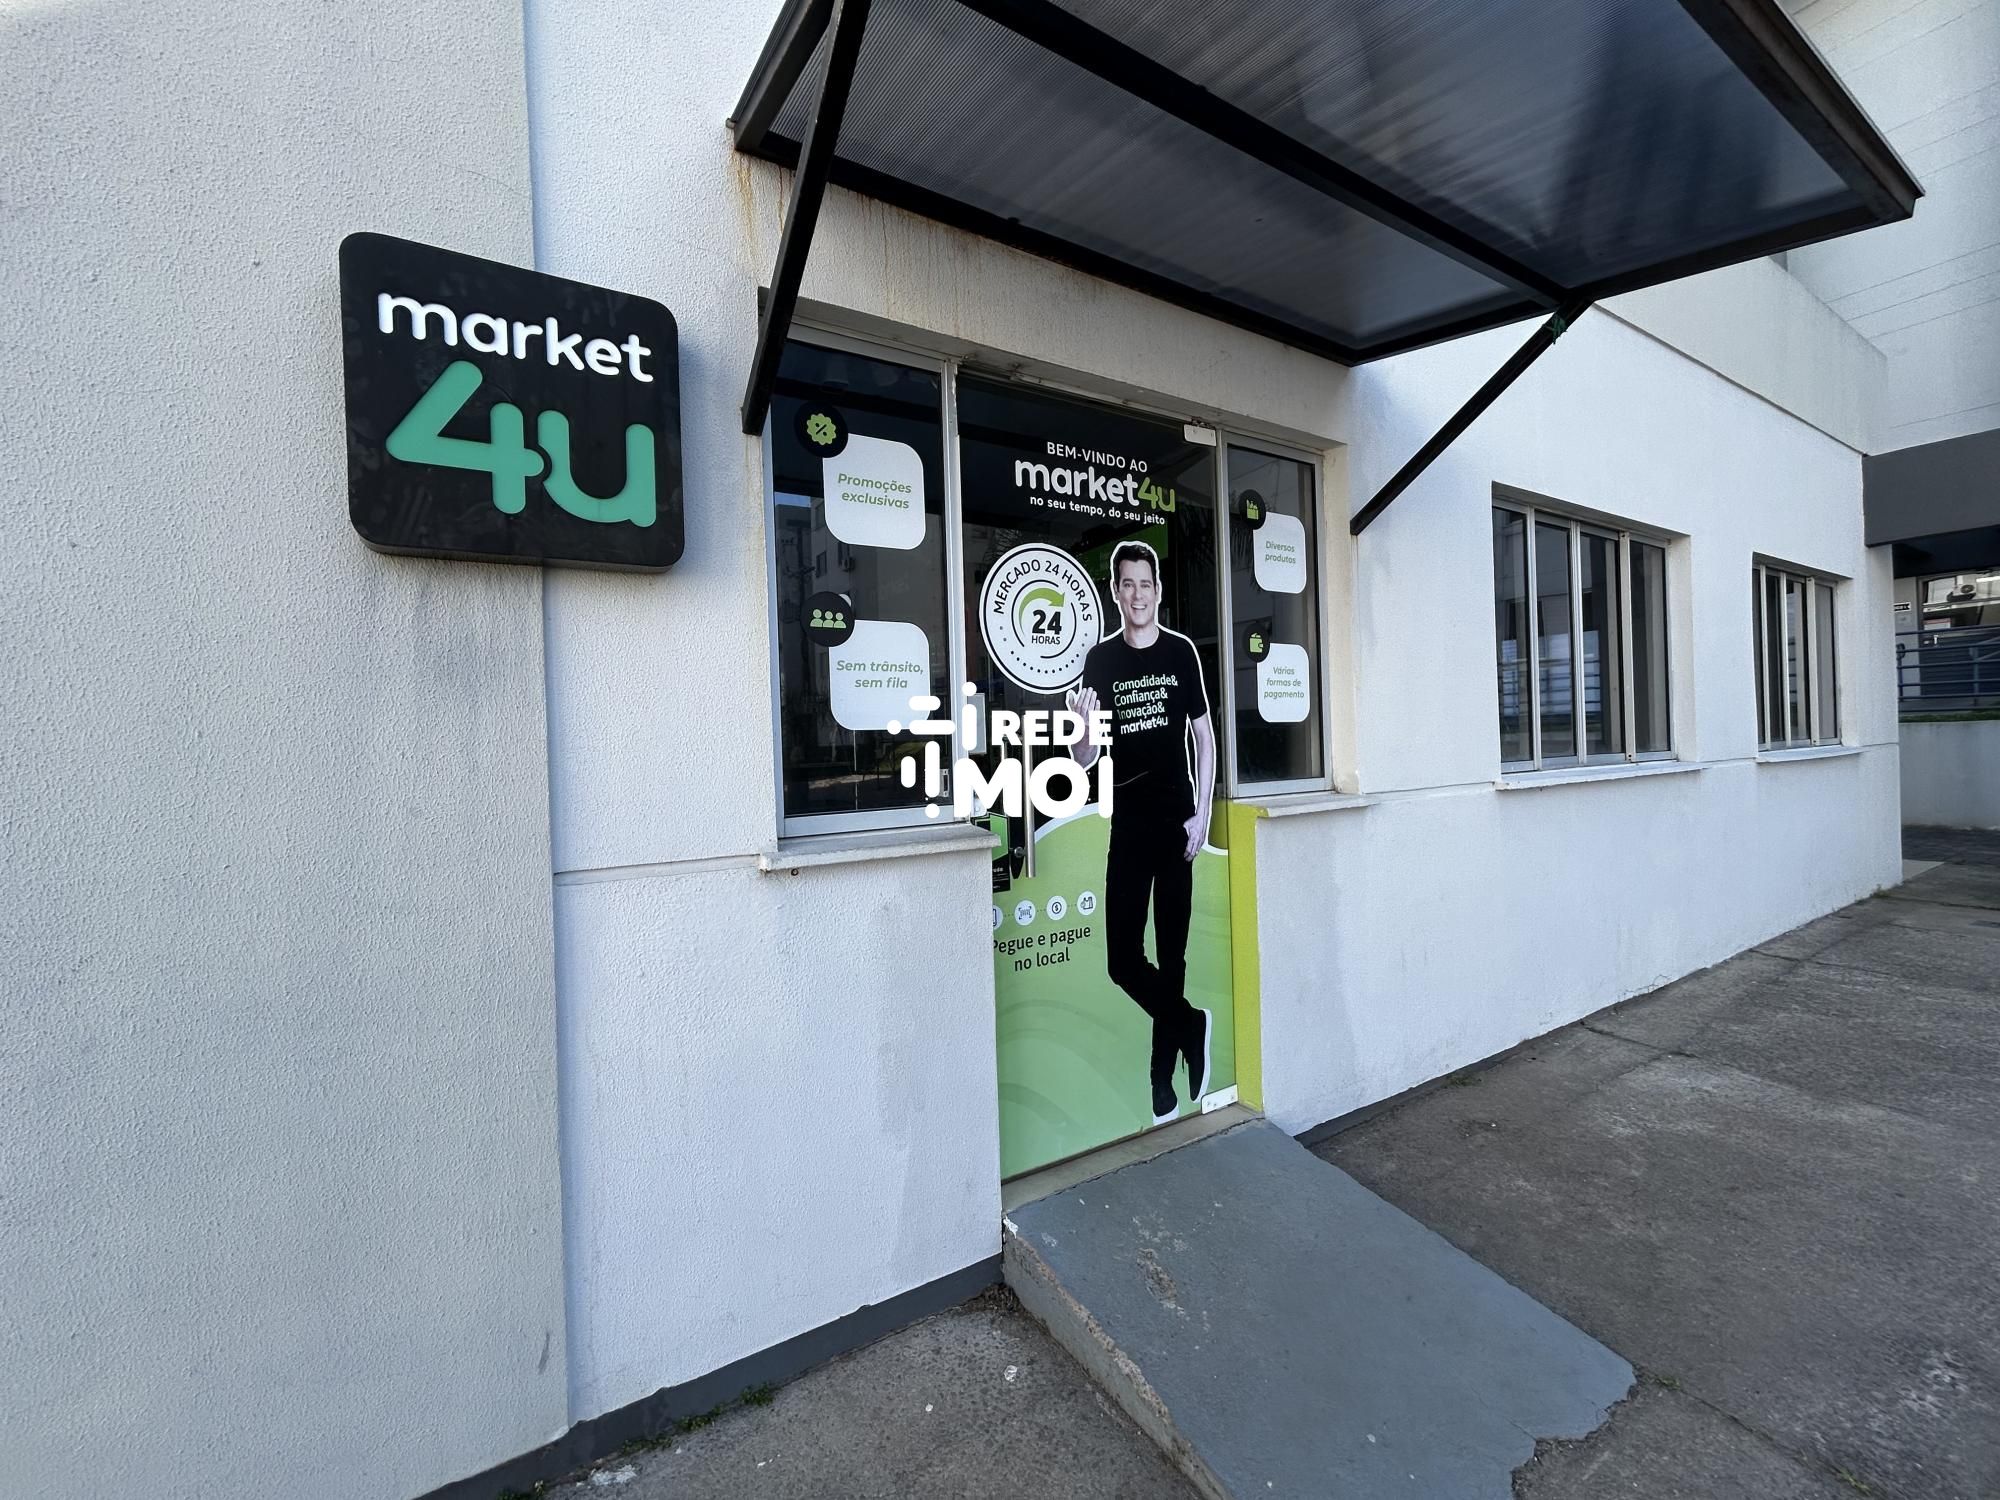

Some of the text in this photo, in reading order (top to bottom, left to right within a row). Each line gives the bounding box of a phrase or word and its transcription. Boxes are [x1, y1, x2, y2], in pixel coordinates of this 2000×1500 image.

[378, 293, 654, 382] market
[1047, 441, 1148, 473] BEM-VINDO AO
[837, 472, 912, 494] Promoções
[1014, 459, 1176, 513] market4u
[841, 491, 910, 509] exclusivas
[1030, 496, 1165, 525] no seu tempo, do seu jeito
[1265, 541, 1295, 553] Diversos
[1264, 553, 1297, 564] produtos
[993, 559, 1093, 622] MERCADO 24 HORAS
[1031, 609, 1062, 635] 24
[1031, 635, 1061, 645] HORAS
[836, 659, 924, 675] Sem trânsito,
[1272, 665, 1295, 675] Várias
[854, 676, 908, 689] sem fila
[1112, 673, 1178, 693] Comodidade&
[1266, 677, 1302, 687] formas de
[1114, 687, 1168, 707] Confiança&
[1263, 690, 1305, 700] pagamento
[1120, 715, 1168, 735] market4u
[1037, 933, 1046, 946] e
[1050, 926, 1091, 947] pague
[1014, 946, 1071, 972] no local
